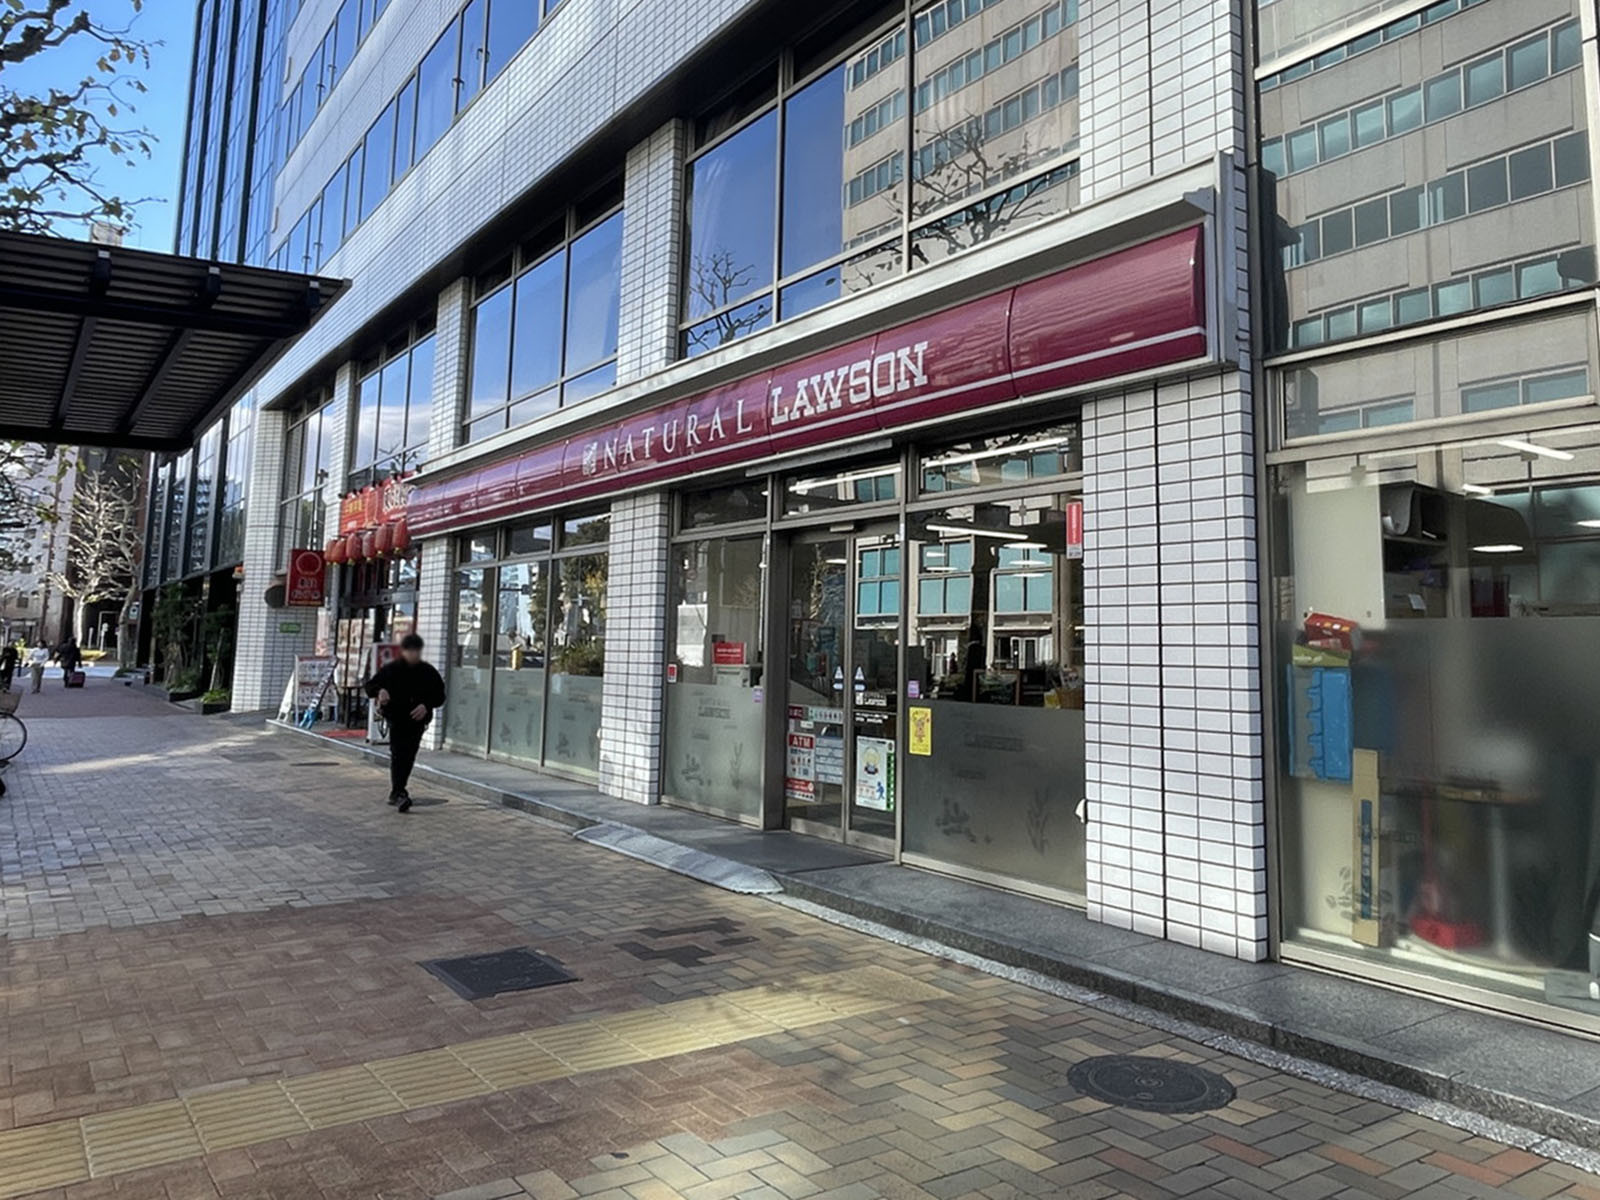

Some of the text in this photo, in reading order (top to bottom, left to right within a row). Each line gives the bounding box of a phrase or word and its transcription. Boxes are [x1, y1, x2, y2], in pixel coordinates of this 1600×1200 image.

[603, 341, 929, 469] NATURAL LAWSON
[792, 736, 811, 747] ATM
